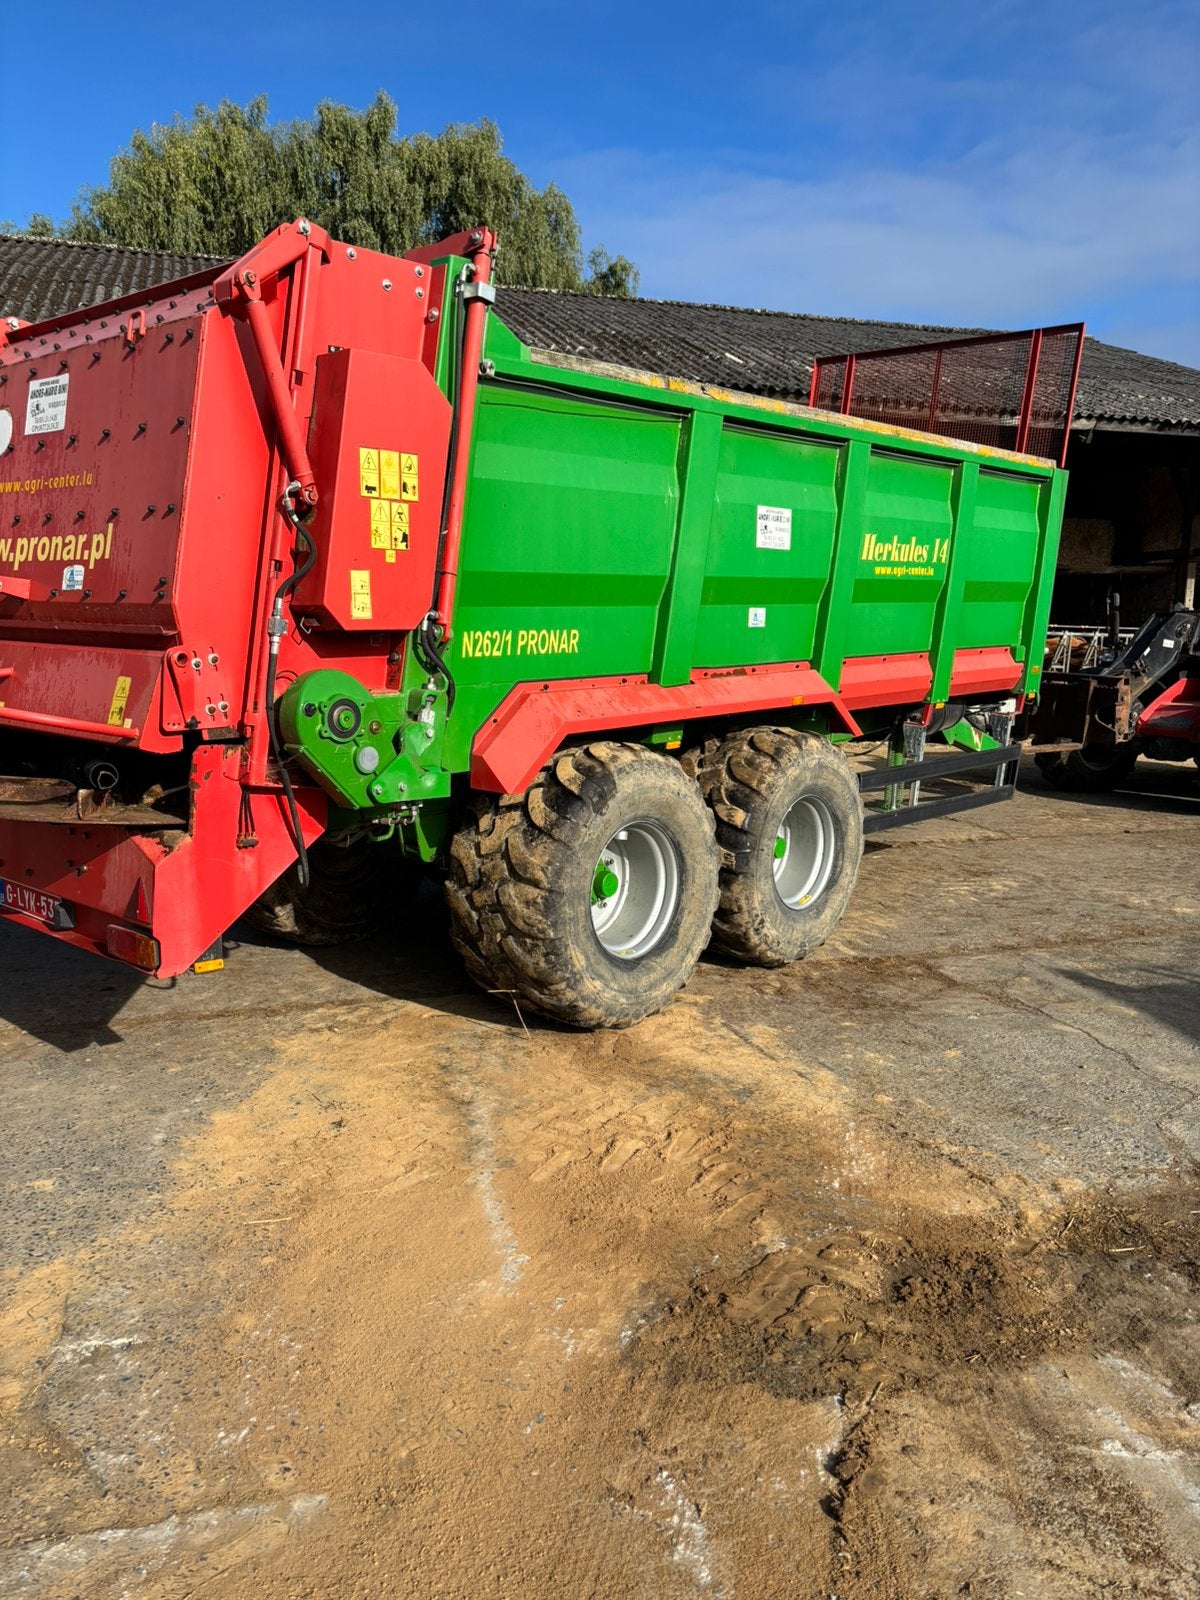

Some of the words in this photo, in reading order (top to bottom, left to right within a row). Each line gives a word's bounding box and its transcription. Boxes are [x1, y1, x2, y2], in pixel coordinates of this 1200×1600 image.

[861, 533, 929, 563] Herkules
[931, 537, 949, 564] 14
[461, 629, 513, 658] N262/1
[516, 629, 580, 656] PRONAR
[6, 884, 60, 918] G-LYK-53
